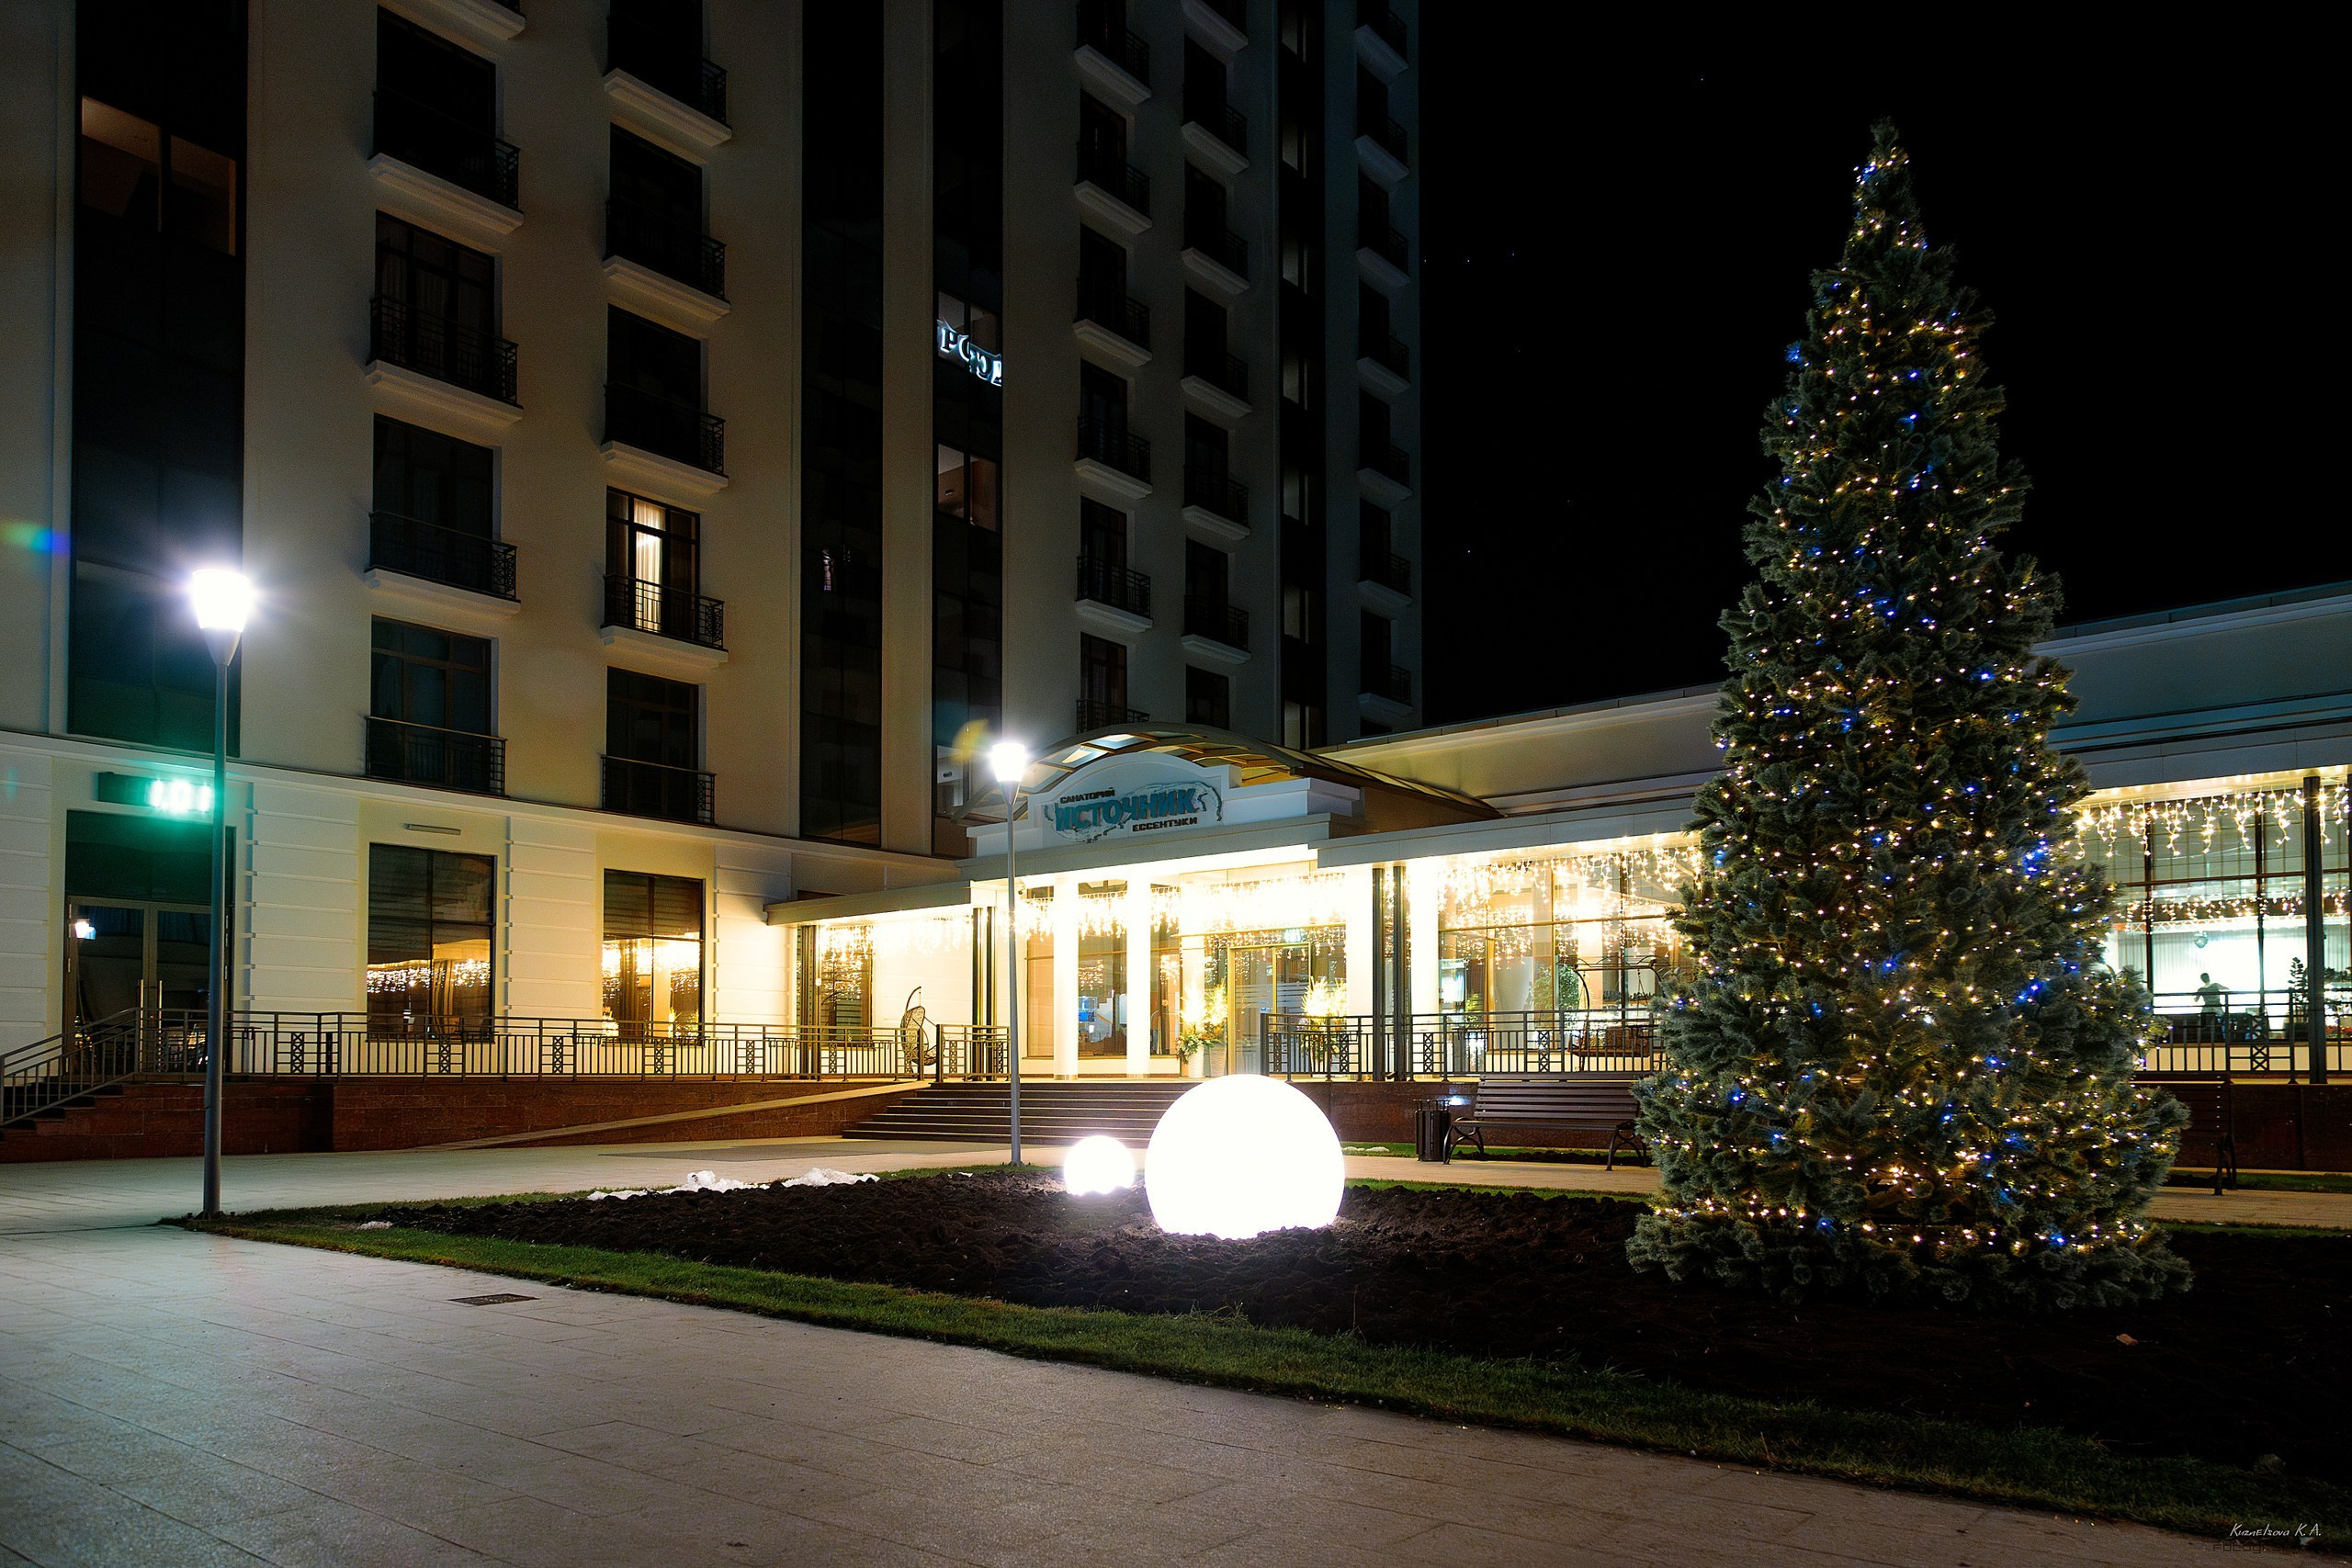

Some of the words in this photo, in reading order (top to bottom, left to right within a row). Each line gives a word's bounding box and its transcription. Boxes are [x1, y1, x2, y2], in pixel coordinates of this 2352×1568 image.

[1059, 787, 1115, 805] САНАТОРИЙ
[1055, 788, 1198, 831] ИСТОЧНИК
[1132, 817, 1198, 832] ЕССЕНТУКИ
